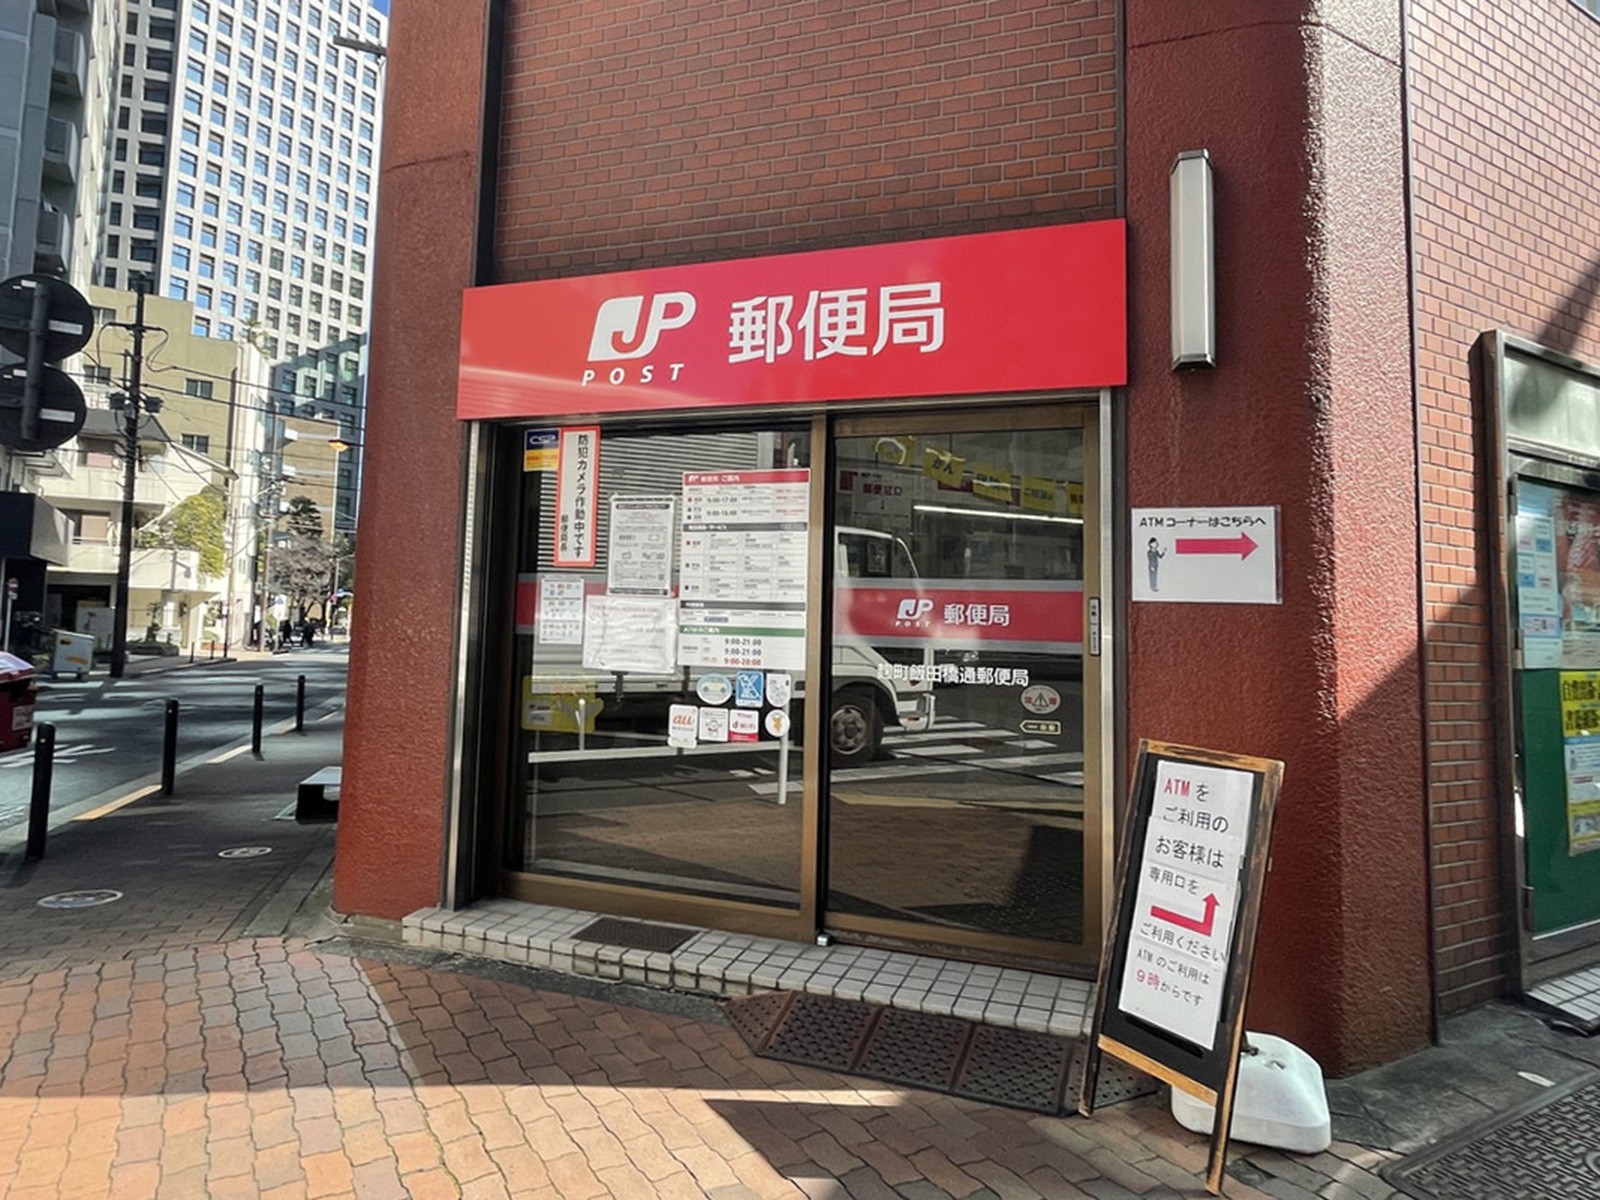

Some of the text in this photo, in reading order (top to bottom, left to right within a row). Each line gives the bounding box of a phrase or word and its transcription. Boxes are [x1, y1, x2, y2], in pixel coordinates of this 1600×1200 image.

[587, 291, 697, 362] JP
[728, 281, 945, 364] 郵便局
[581, 362, 685, 387] POST
[573, 434, 589, 558] 防犯カメラ作動中です
[1139, 516, 1266, 528] ATMコーナーはこちらへ
[897, 599, 934, 620] JP
[943, 603, 1010, 626] 郵便局
[673, 714, 693, 726] au
[1163, 806, 1229, 833] ご利用の
[1155, 836, 1224, 868] お客様は
[1148, 866, 1199, 895] 専用口を
[1140, 922, 1226, 962] ご利用ください
[1136, 969, 1203, 1006] 9時からです
